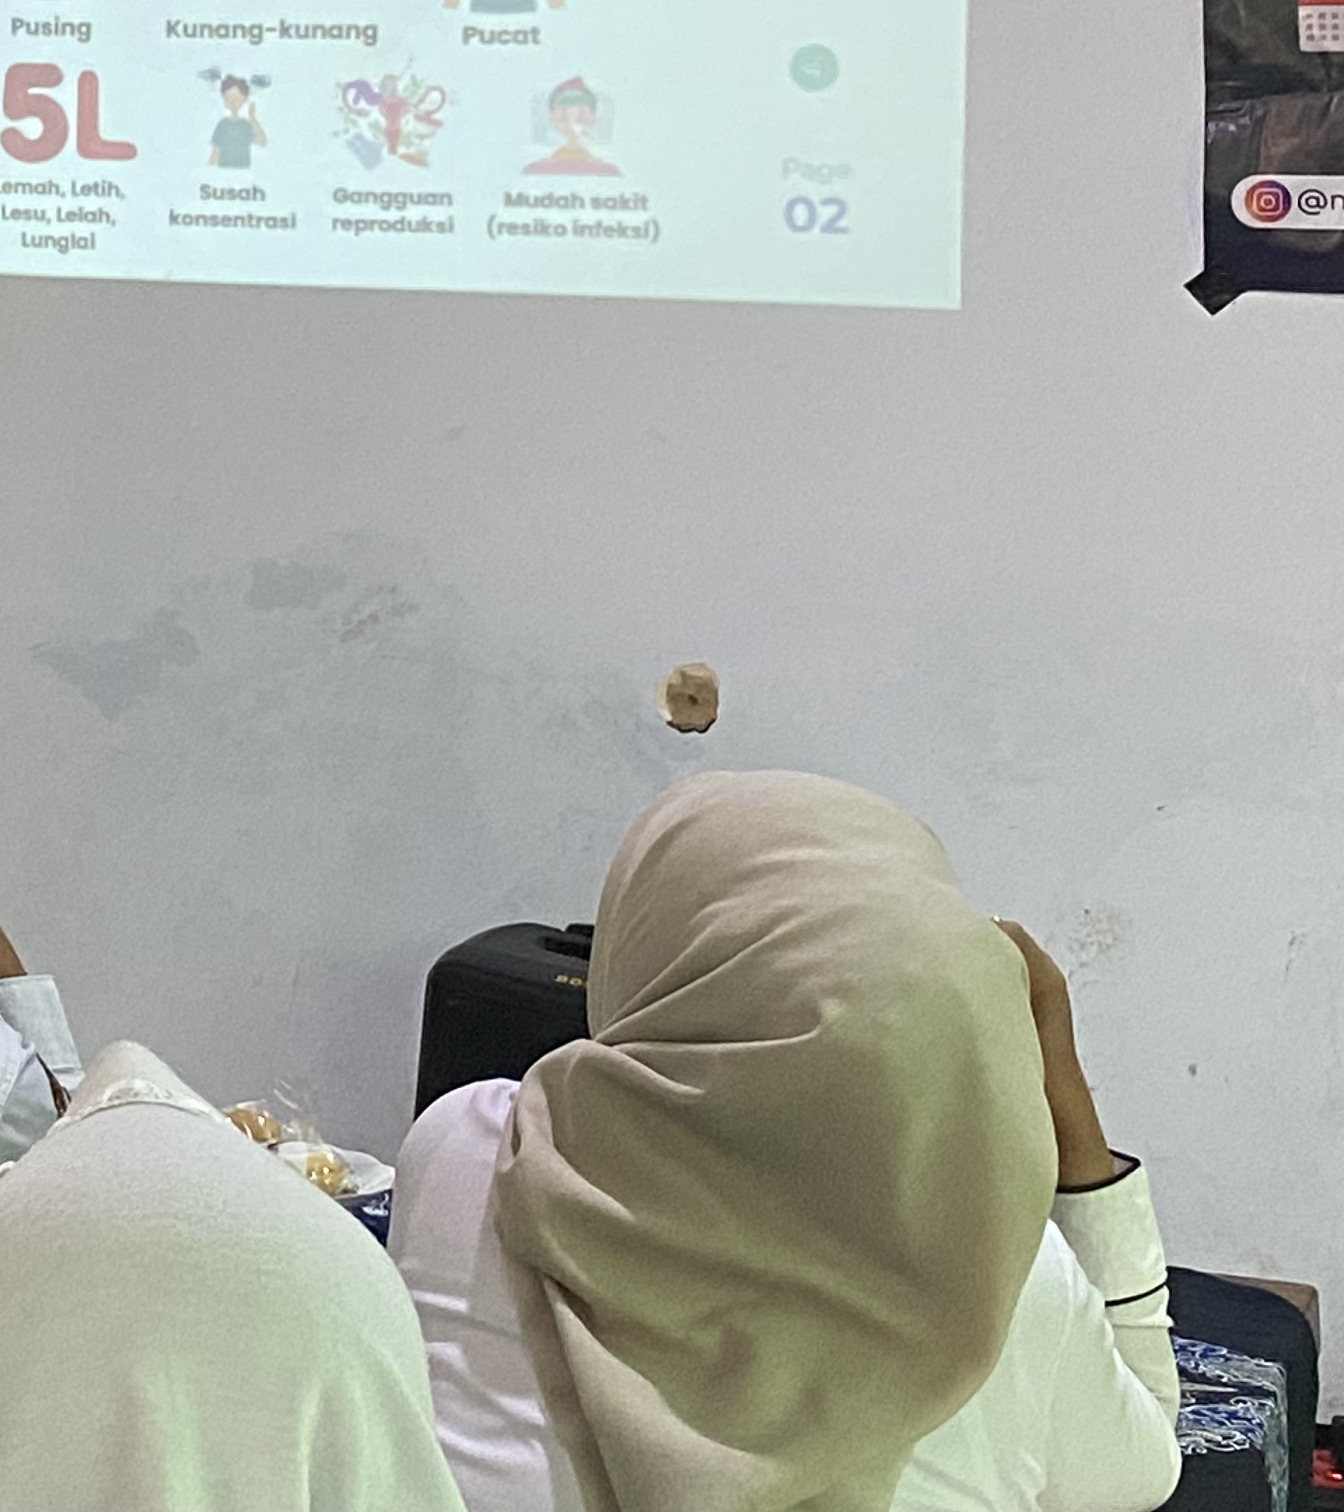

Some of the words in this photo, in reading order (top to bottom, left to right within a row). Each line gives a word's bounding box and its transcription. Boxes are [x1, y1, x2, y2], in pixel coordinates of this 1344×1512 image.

[12, 16, 92, 43] Pusing
[165, 19, 379, 46] Kunang-kunang
[462, 25, 541, 46] Pucat
[0, 62, 138, 164] 5L
[782, 157, 851, 184] Page
[70, 179, 126, 200] Letih,
[199, 184, 267, 203] Susah
[332, 187, 454, 210] Gangguan
[503, 191, 586, 210] Mudah
[590, 193, 649, 211] sakit
[1, 204, 52, 225] Lesu,
[56, 206, 117, 227] Lelah,
[169, 208, 298, 231] konsentrasi
[332, 215, 455, 236] reproduksi
[783, 196, 851, 235] 02
[487, 214, 568, 240] (resiko
[572, 217, 661, 244] infeksi)
[21, 231, 96, 253] Lunglai
